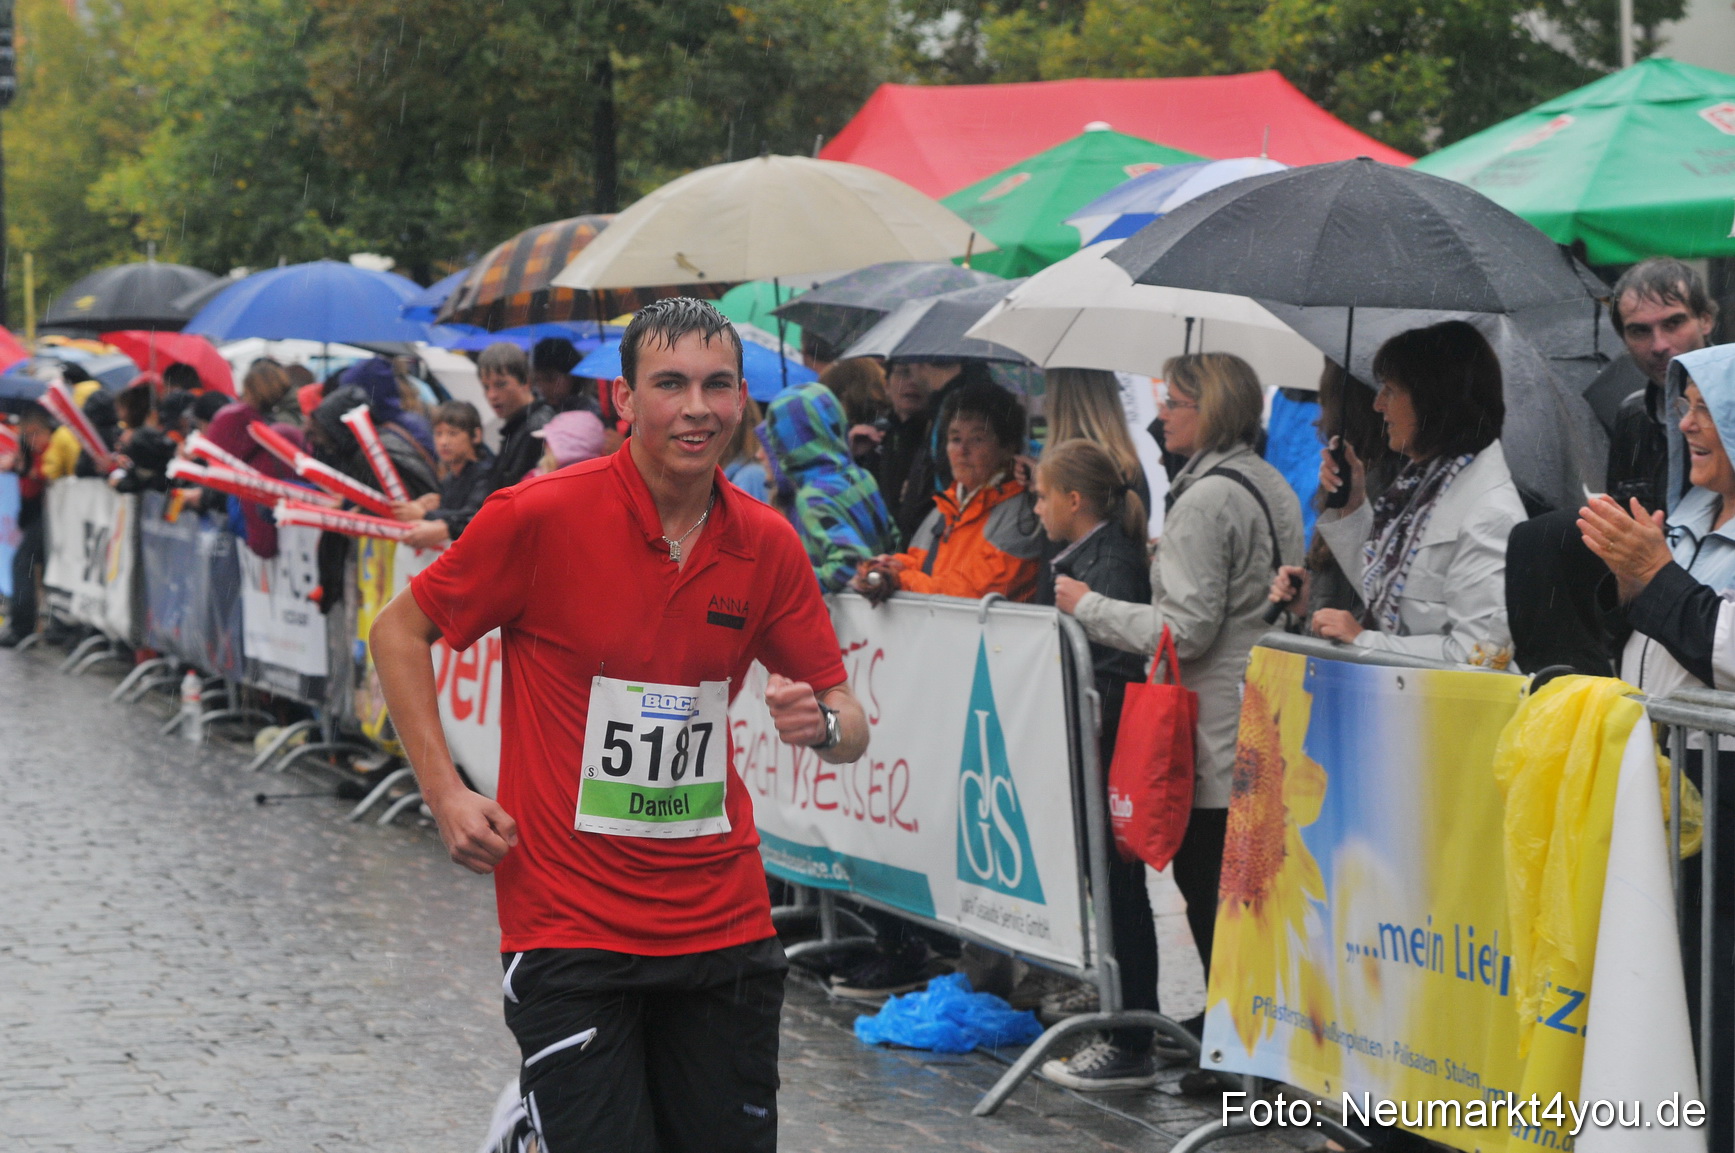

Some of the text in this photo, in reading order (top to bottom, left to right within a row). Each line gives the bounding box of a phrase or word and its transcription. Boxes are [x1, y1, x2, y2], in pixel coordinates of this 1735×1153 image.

[707, 594, 749, 617] ANNA
[601, 720, 713, 782] 5187
[629, 792, 690, 816] Daniel
